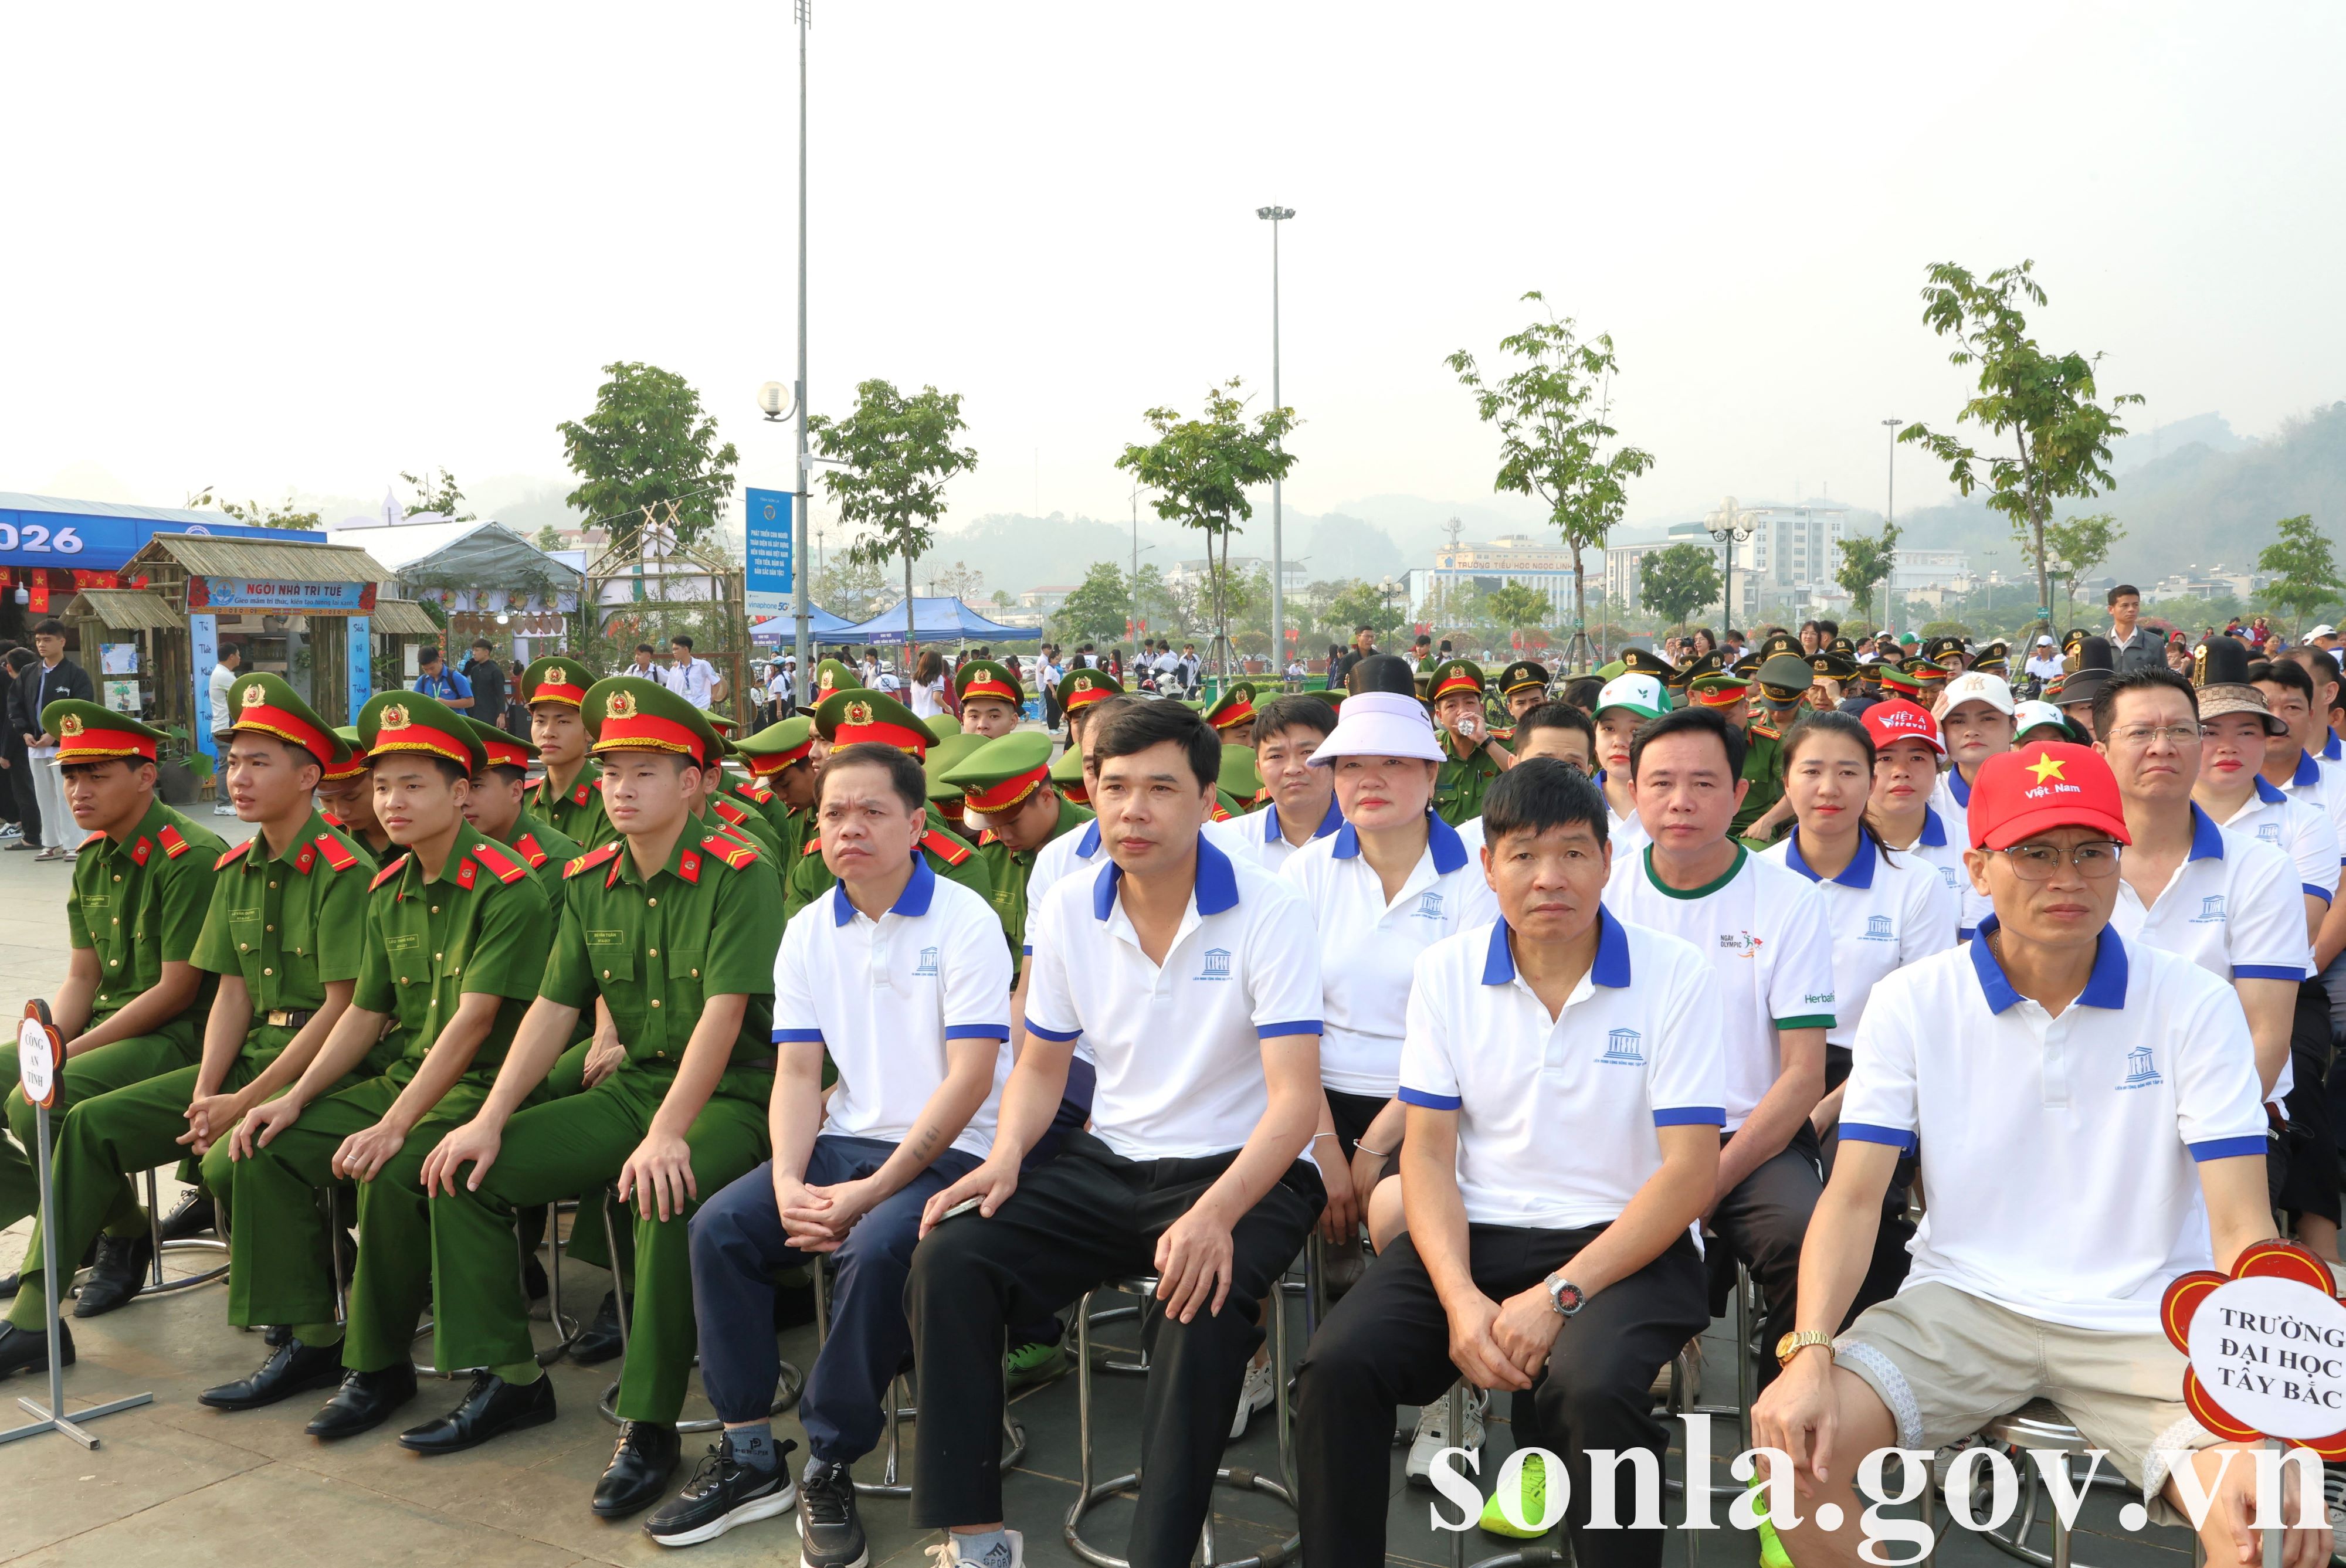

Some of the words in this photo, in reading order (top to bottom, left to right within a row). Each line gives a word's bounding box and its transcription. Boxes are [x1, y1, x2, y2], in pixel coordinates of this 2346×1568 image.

[760, 529, 769, 537] TRIỂN
[1458, 560, 1490, 569] TRƯỜNG
[1494, 559, 1511, 569] TIỂU
[247, 582, 275, 595] NGÔI
[279, 583, 300, 595] NHÀ
[304, 584, 321, 596] TRÍ
[324, 585, 342, 599] TUỆ
[748, 601, 777, 609] vinaphone
[778, 602, 789, 611] 5G
[1895, 721, 1927, 731] travel
[2025, 786, 2050, 799] Việt
[2055, 783, 2081, 793] Nam
[25, 1032, 43, 1050] CÔNG
[1609, 1036, 1639, 1053] UNESCO
[30, 1055, 39, 1067] AN
[27, 1070, 43, 1087] TỈNH
[2220, 1307, 2345, 1348] TRƯỜNG
[2219, 1337, 2270, 1365] ĐẠI
[2278, 1349, 2342, 1379] HỌC
[2218, 1366, 2276, 1395] TÂY
[2282, 1380, 2342, 1409] BẮC
